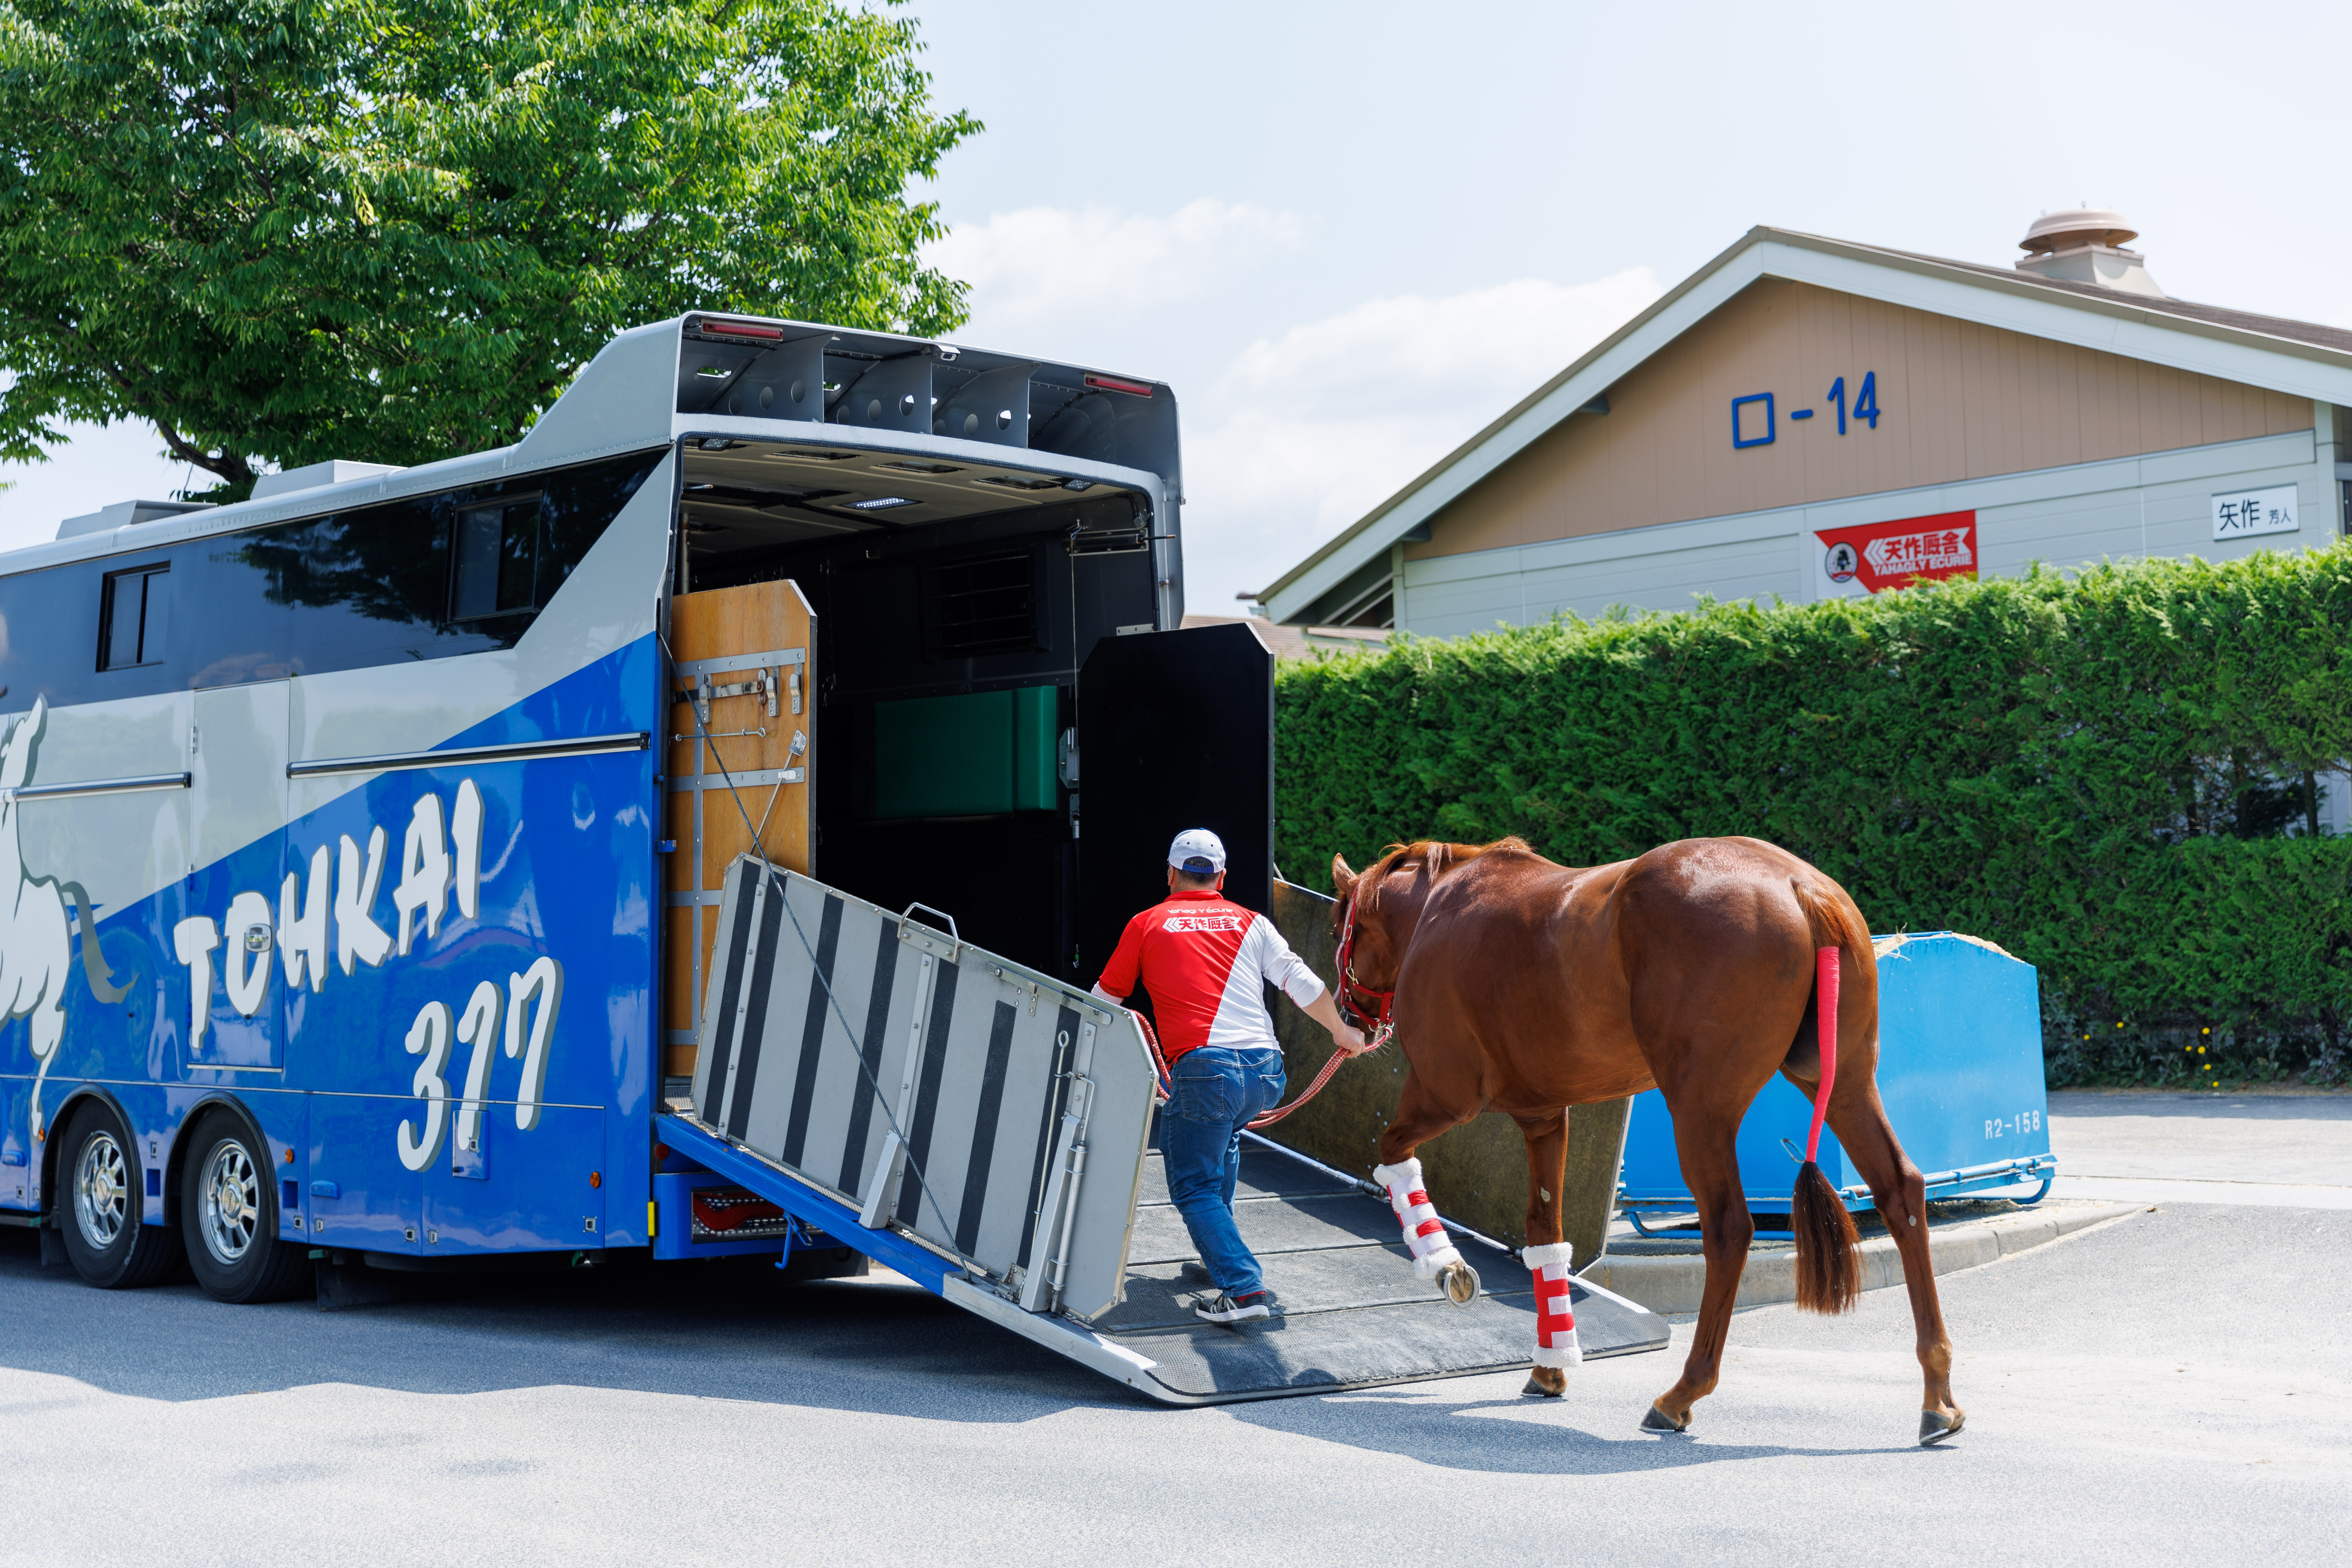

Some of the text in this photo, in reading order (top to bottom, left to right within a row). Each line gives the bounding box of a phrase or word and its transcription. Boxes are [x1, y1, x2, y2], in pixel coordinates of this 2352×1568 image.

[2220, 499, 2260, 530] 矢作
[1929, 554, 1973, 570] ECURIE
[174, 777, 485, 1049] TOHKAI
[1985, 1110, 2040, 1140] R2-158
